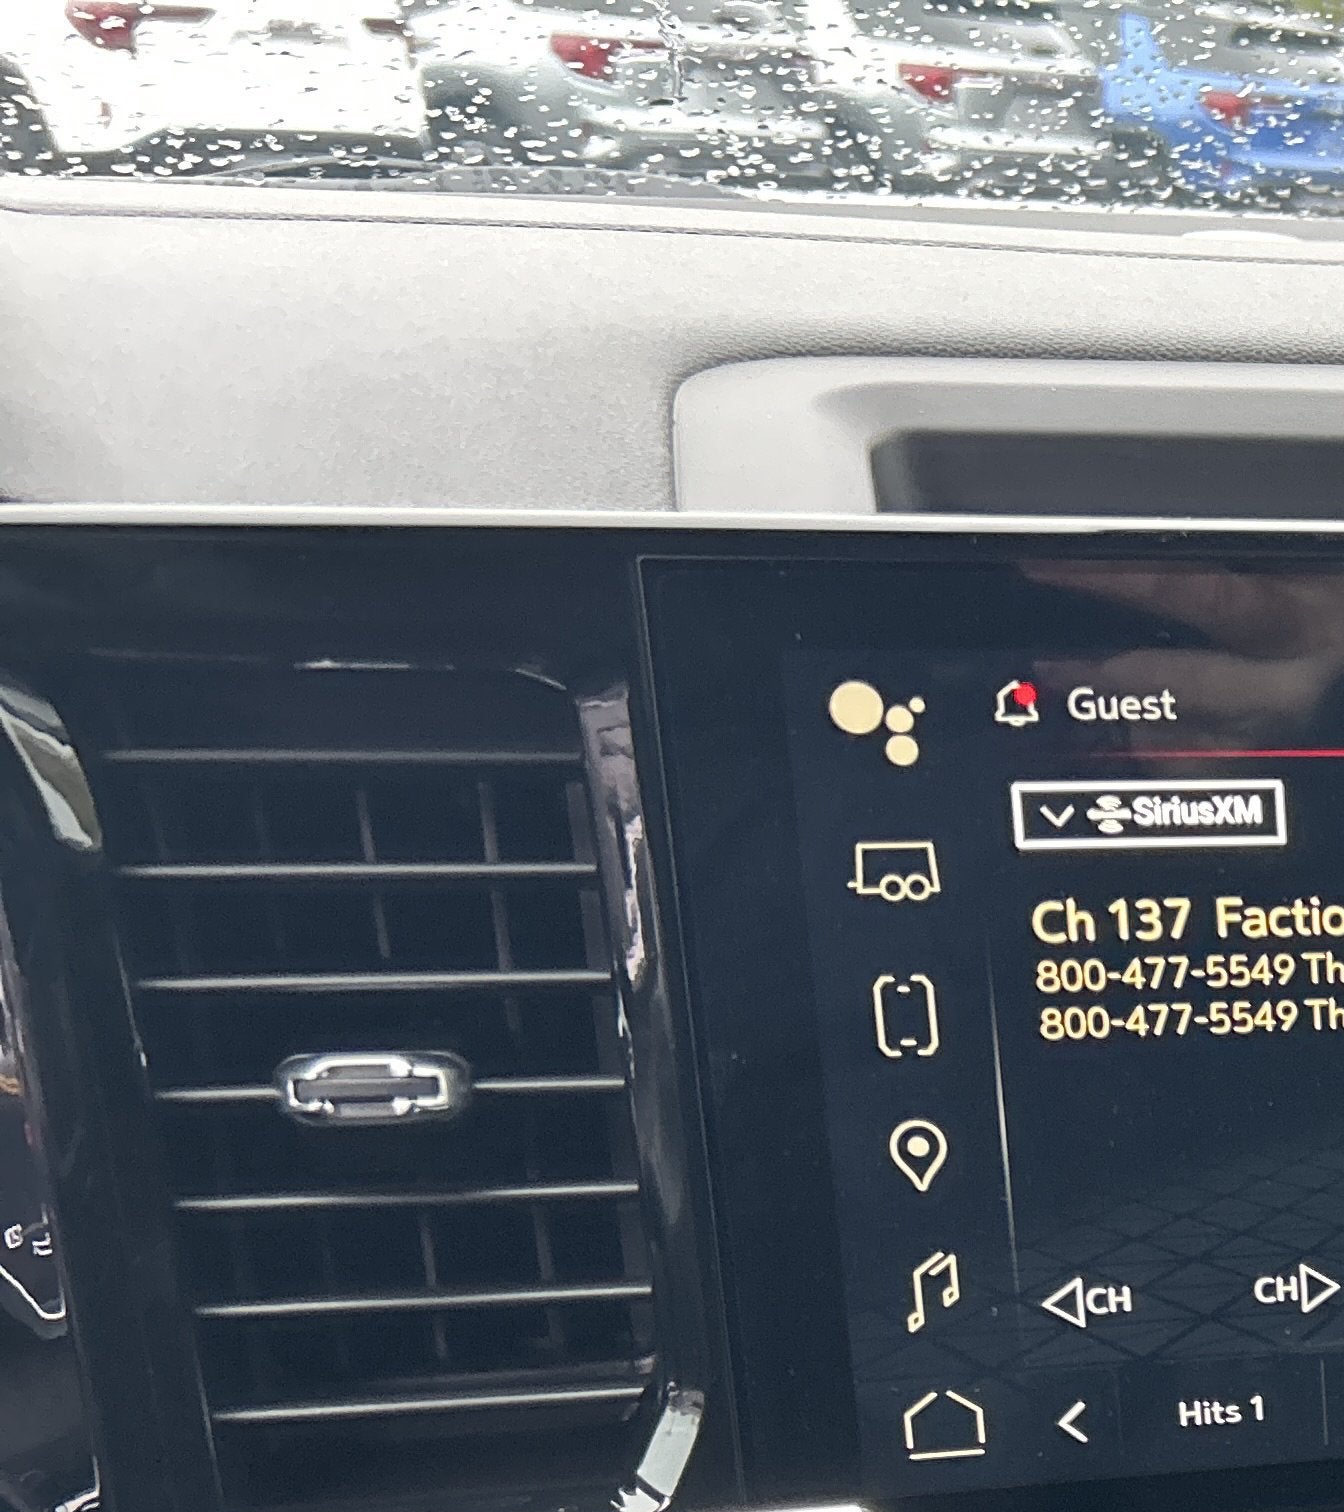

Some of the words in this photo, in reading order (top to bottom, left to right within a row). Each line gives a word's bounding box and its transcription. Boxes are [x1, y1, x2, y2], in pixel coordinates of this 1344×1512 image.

[1068, 687, 1177, 720] Guest
[1132, 795, 1263, 826] SiriusXM
[1032, 897, 1096, 943] Ch
[1108, 898, 1191, 941] 137
[1036, 954, 1295, 993] 800-477-5549
[1040, 1000, 1298, 1040] 800-477-5549
[1087, 1285, 1132, 1314] CH
[1254, 1276, 1298, 1303] CH
[1179, 1401, 1242, 1426] Hits
[1250, 1396, 1263, 1420] 1
